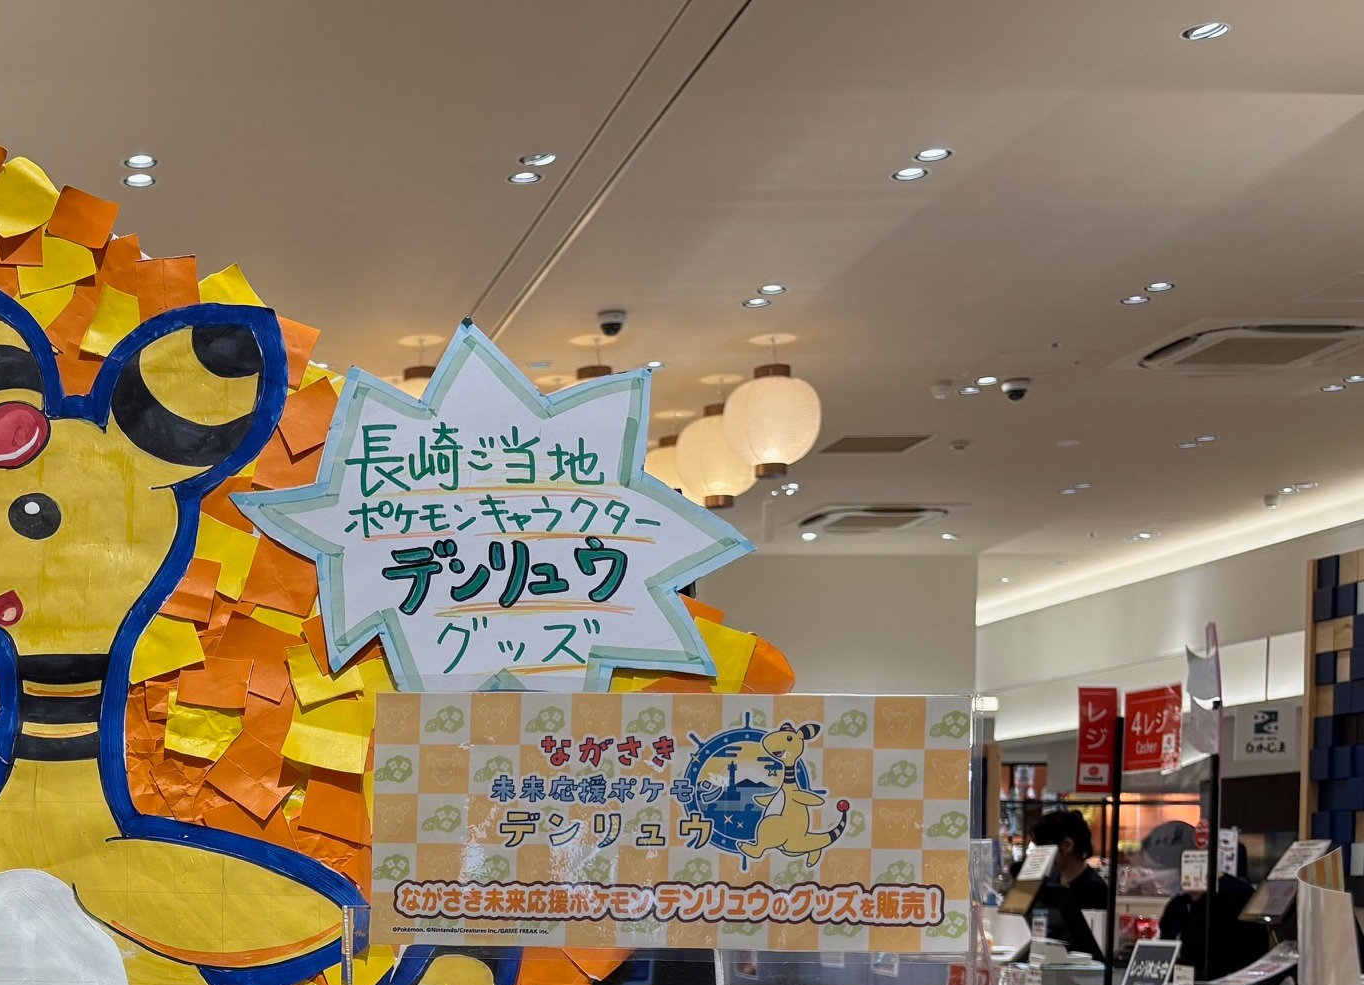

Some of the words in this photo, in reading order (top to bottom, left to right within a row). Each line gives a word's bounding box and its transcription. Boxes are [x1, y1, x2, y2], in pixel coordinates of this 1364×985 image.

[345, 421, 605, 497] 長崎ご当地
[344, 494, 661, 538] ポケモンキャラクター
[382, 536, 628, 615] デンリュウ
[437, 616, 600, 674] グッズ
[1086, 701, 1108, 750] レジ
[541, 735, 675, 767] ながさき
[491, 774, 724, 806] 未来応援ポケモン
[499, 811, 713, 849] デンリュウ
